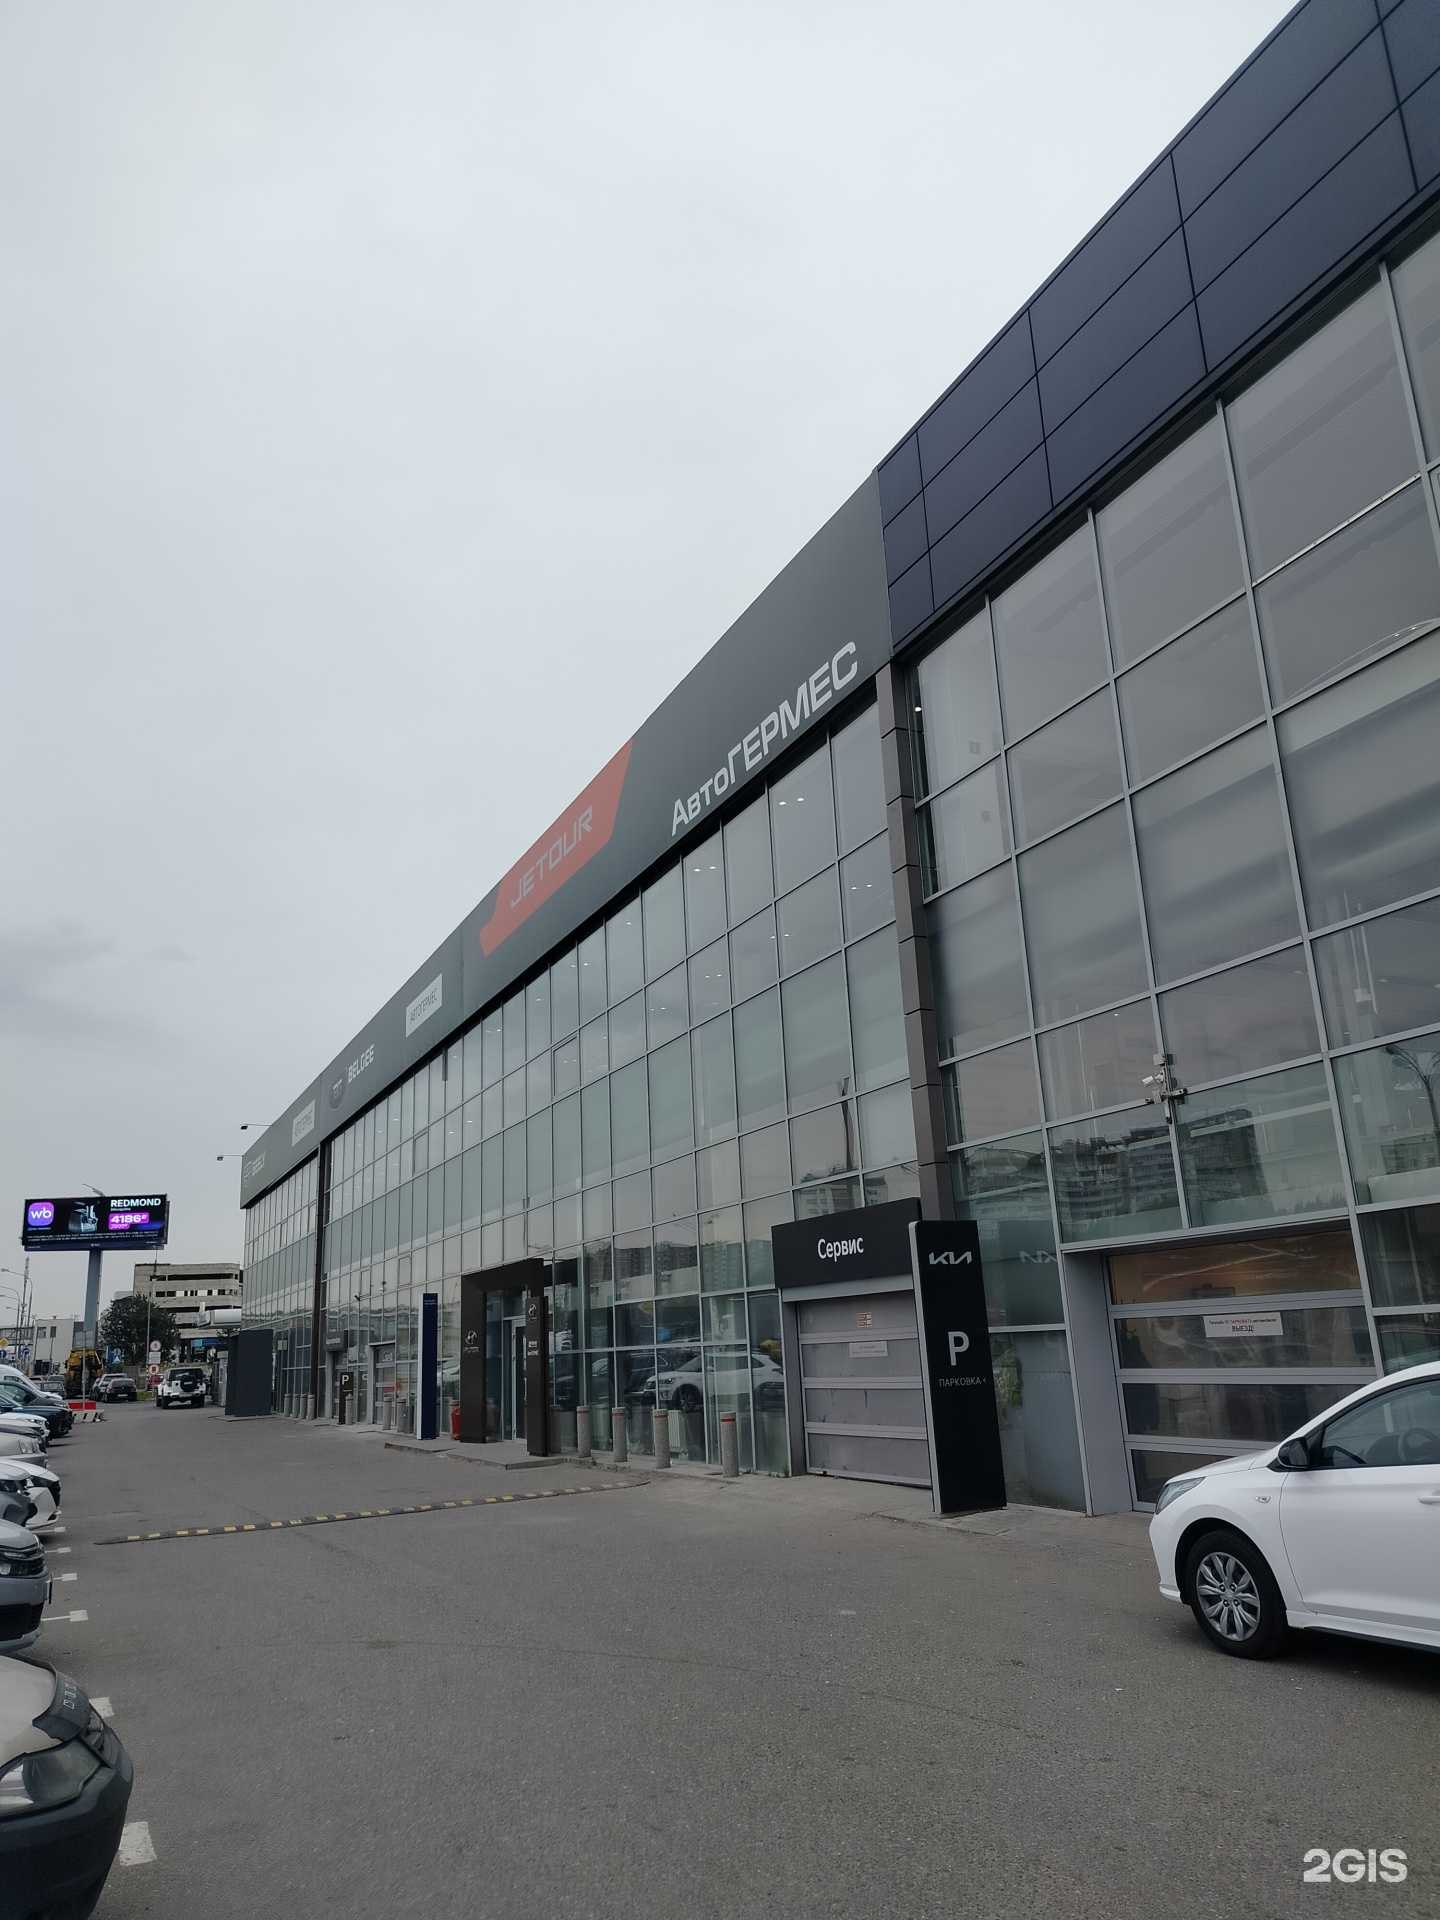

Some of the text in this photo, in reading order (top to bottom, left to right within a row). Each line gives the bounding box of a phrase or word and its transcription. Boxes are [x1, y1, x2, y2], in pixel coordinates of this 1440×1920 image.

[671, 640, 859, 837] АвтоГЕРМЕС
[510, 805, 593, 909] JETOUR
[348, 1044, 375, 1083] BELGEE
[110, 1198, 161, 1208] REDMOND
[817, 1235, 864, 1262] Сервис
[928, 1251, 973, 1265] KIA
[947, 1331, 970, 1366] P
[341, 1374, 350, 1386] P
[938, 1376, 982, 1388] ПАРКОВКА
